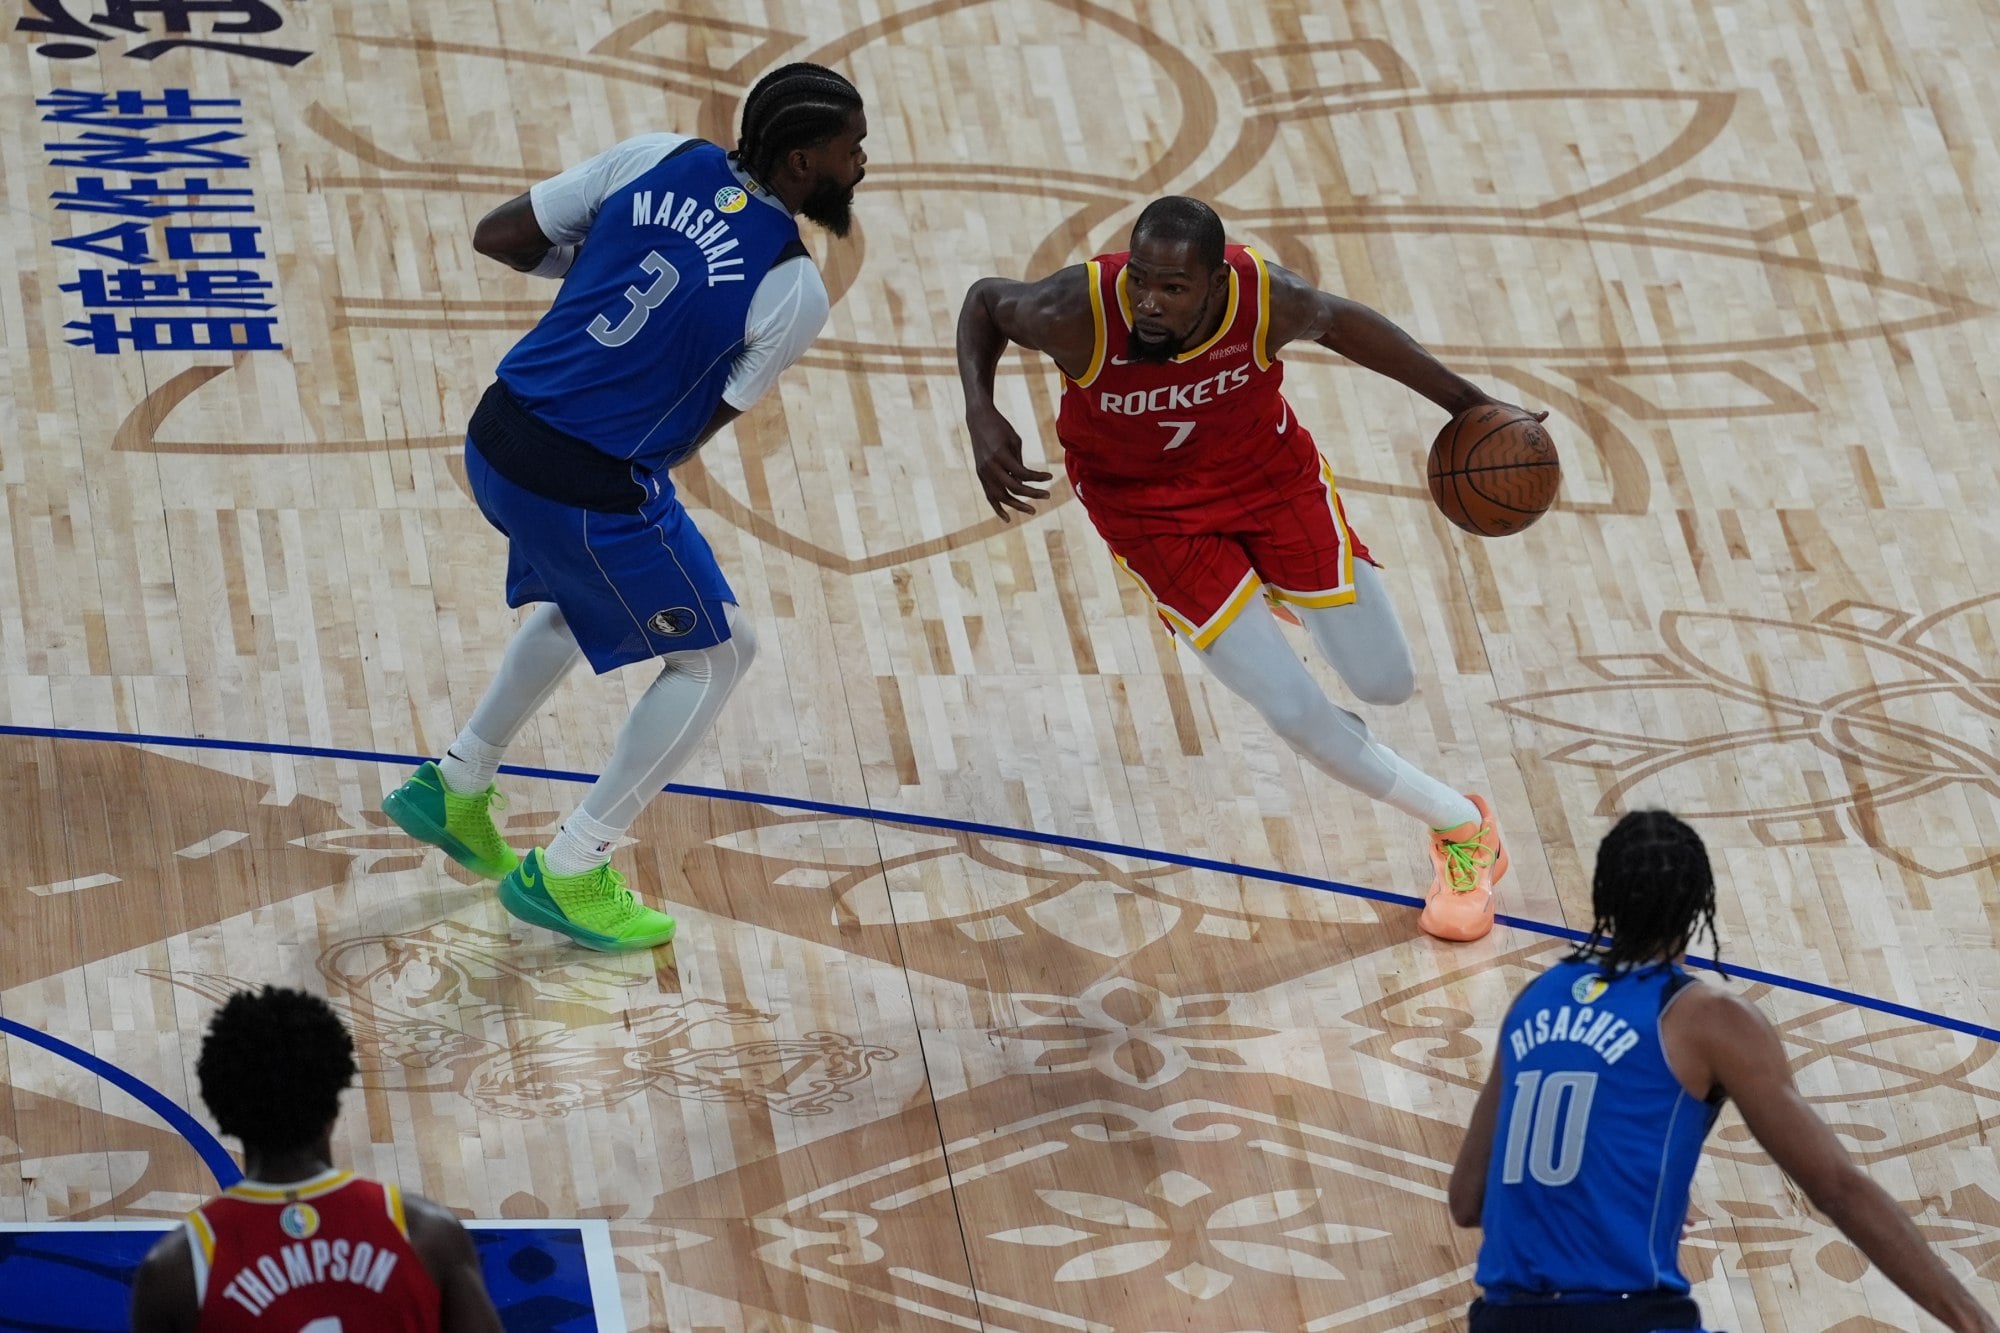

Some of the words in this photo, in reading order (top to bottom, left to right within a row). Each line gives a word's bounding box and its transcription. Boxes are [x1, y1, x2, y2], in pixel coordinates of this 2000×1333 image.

[35, 88, 284, 355] 首席合作伙伴
[632, 190, 745, 287] MARSHALL
[585, 250, 680, 347] 3
[1101, 362, 1250, 416] ROCKETS
[1158, 421, 1196, 451] 7
[1510, 1005, 1640, 1066] RISACHER
[1502, 1070, 1599, 1187] 10
[223, 1238, 399, 1317] THOMPSON
